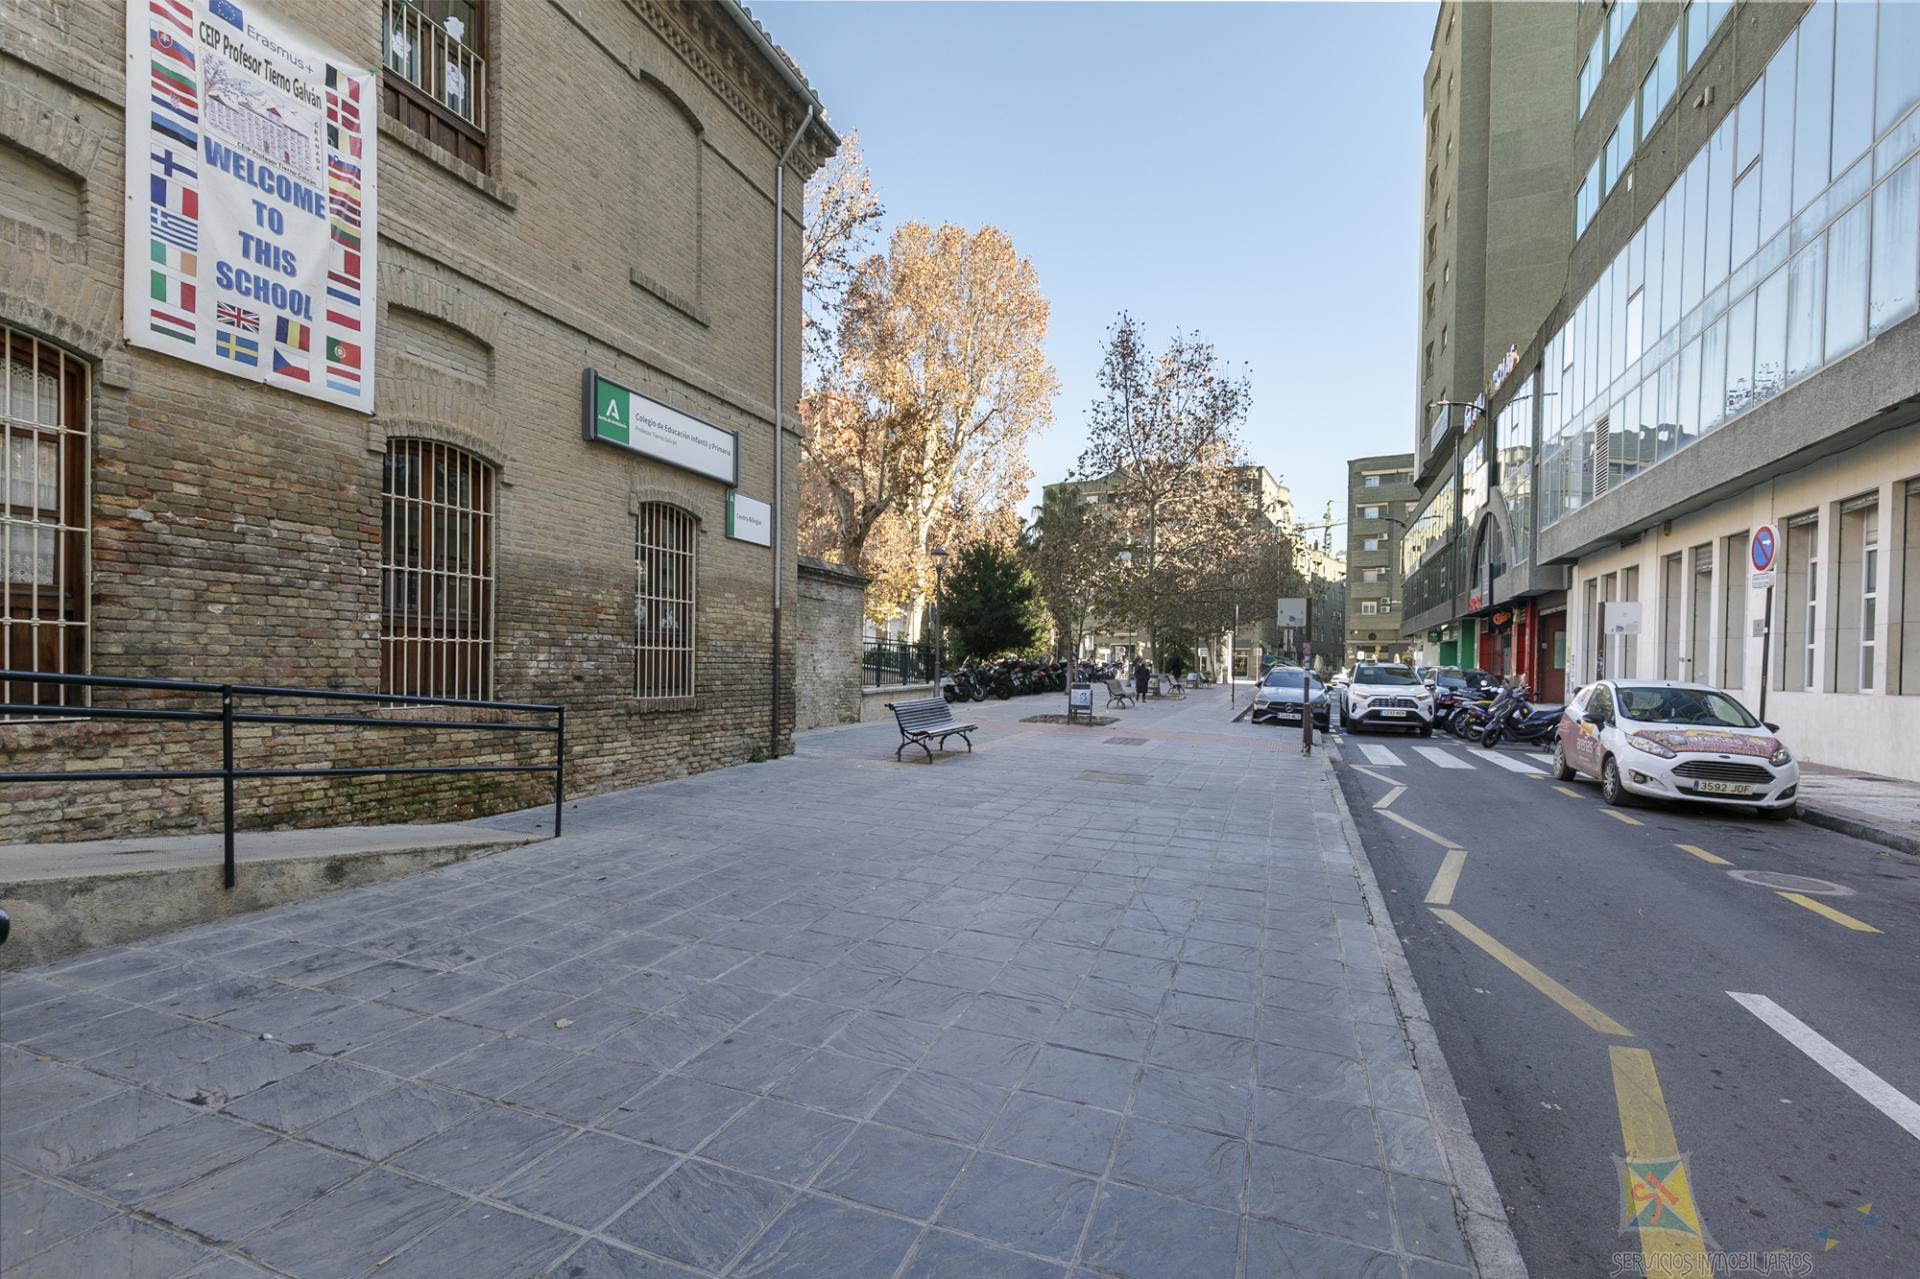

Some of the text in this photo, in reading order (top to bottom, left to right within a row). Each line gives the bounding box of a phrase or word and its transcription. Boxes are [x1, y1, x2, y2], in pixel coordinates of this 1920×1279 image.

[199, 21, 322, 109] CEIP Profesor Tierno Galván
[247, 24, 314, 74] Erasmus+
[203, 135, 326, 220] WELCOME
[252, 198, 284, 236] TO
[239, 230, 297, 278] THIS
[216, 260, 312, 322] SCHOOL
[635, 412, 656, 429] Colegio
[656, 421, 664, 431] de
[664, 424, 691, 441] Educación
[691, 434, 708, 447] Infantil
[712, 442, 731, 456] Primaria
[1700, 781, 1751, 793] 3592 JDF
